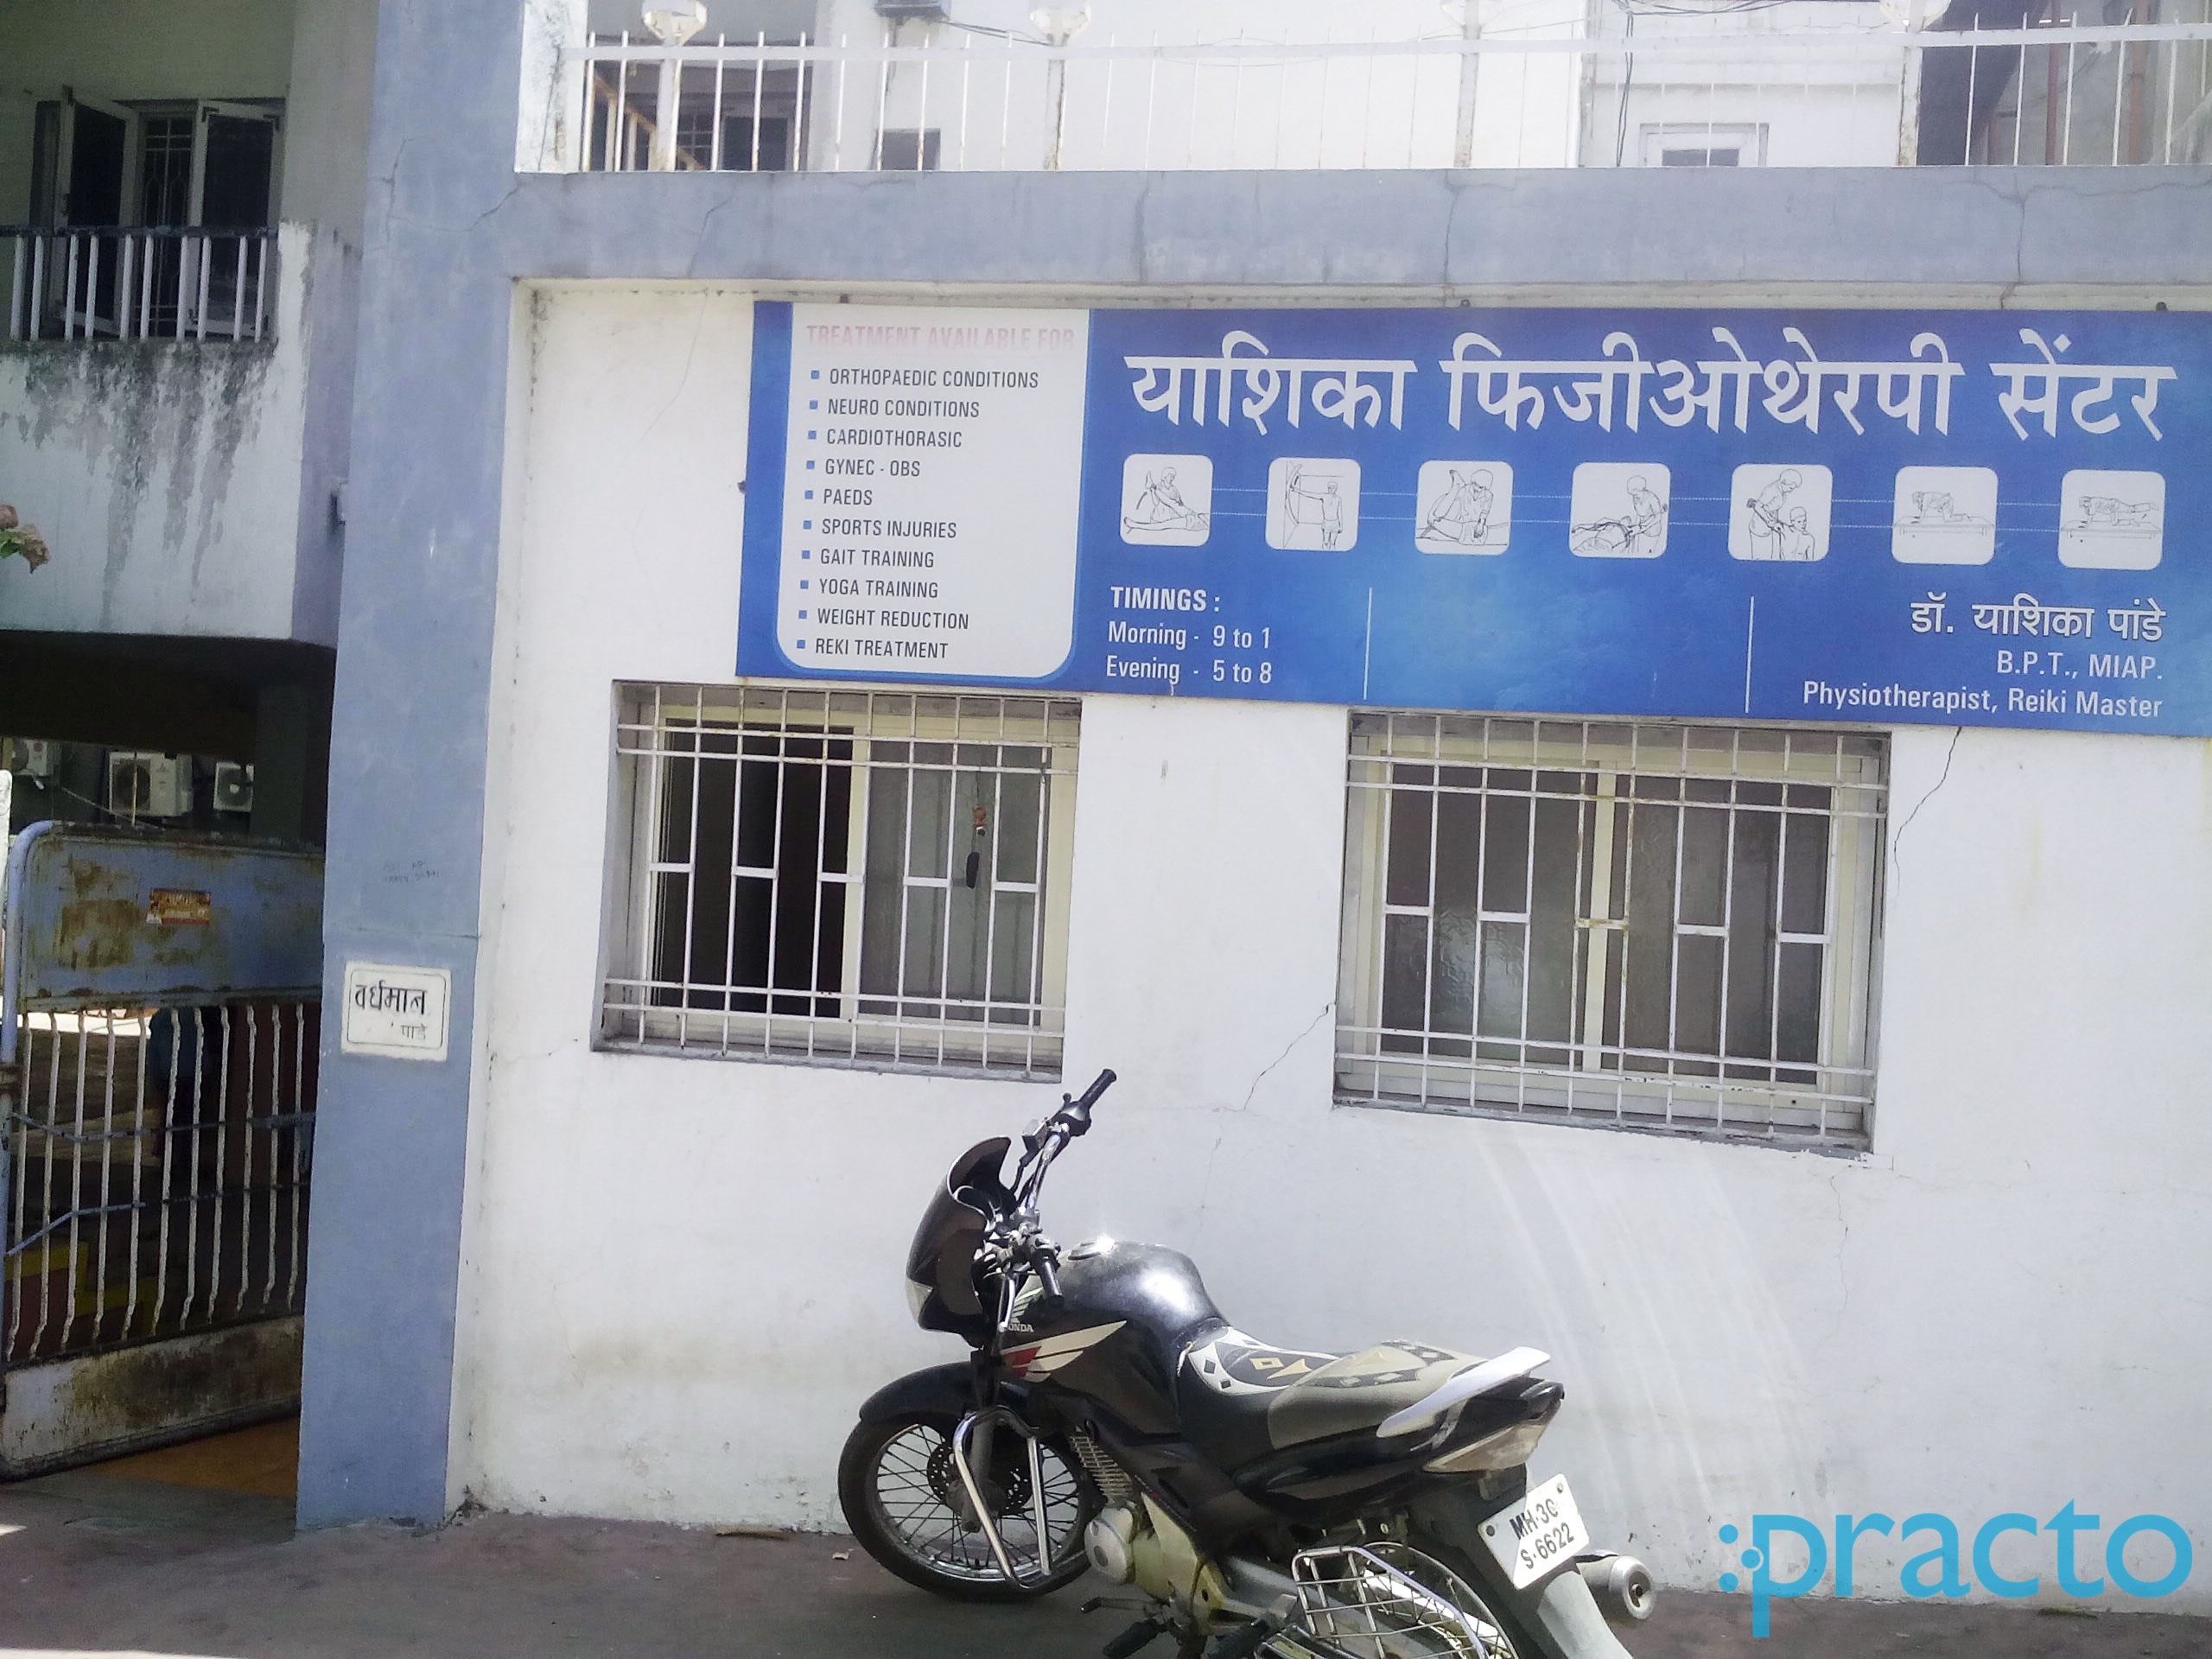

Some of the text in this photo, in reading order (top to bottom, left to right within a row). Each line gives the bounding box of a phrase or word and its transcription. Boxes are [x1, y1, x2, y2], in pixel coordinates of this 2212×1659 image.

[806, 325, 921, 349] TREATMENT
[830, 368, 1039, 389] ORTHOPAEDIC CONDITIONS
[1123, 327, 2178, 441] याशिका फिजीओथेरपी सेंटर
[828, 399, 980, 418] NEURO CONDITIONS
[827, 429, 963, 448] CARDIOTHORASIC
[825, 459, 875, 476] GYNEC
[890, 461, 920, 477] OBS
[823, 489, 873, 506] PAEDS
[822, 518, 957, 539] SPORTS INJURIES
[820, 549, 934, 569] GAIT TRAINING
[819, 579, 938, 599] YOGA TRAINING
[817, 608, 969, 630] WEIGHT REDUCTION
[1910, 591, 2167, 641] डॉ. याशिका पांडे
[1108, 620, 1186, 651] Morning
[1212, 625, 1225, 647] 9
[1232, 628, 1252, 649] to
[1262, 626, 1270, 649] 1
[815, 638, 949, 659] REKI TREATMENT
[1106, 654, 1180, 684] Evening
[1212, 659, 1225, 682] 5
[1232, 663, 1252, 683] to
[1259, 661, 1272, 684] 8
[2088, 653, 2163, 681] MIAP.
[1803, 681, 2164, 718] Physiotherapist, Reiki Master
[355, 979, 428, 1015] वर्धमान
[1007, 1323, 1034, 1332] ONDA
